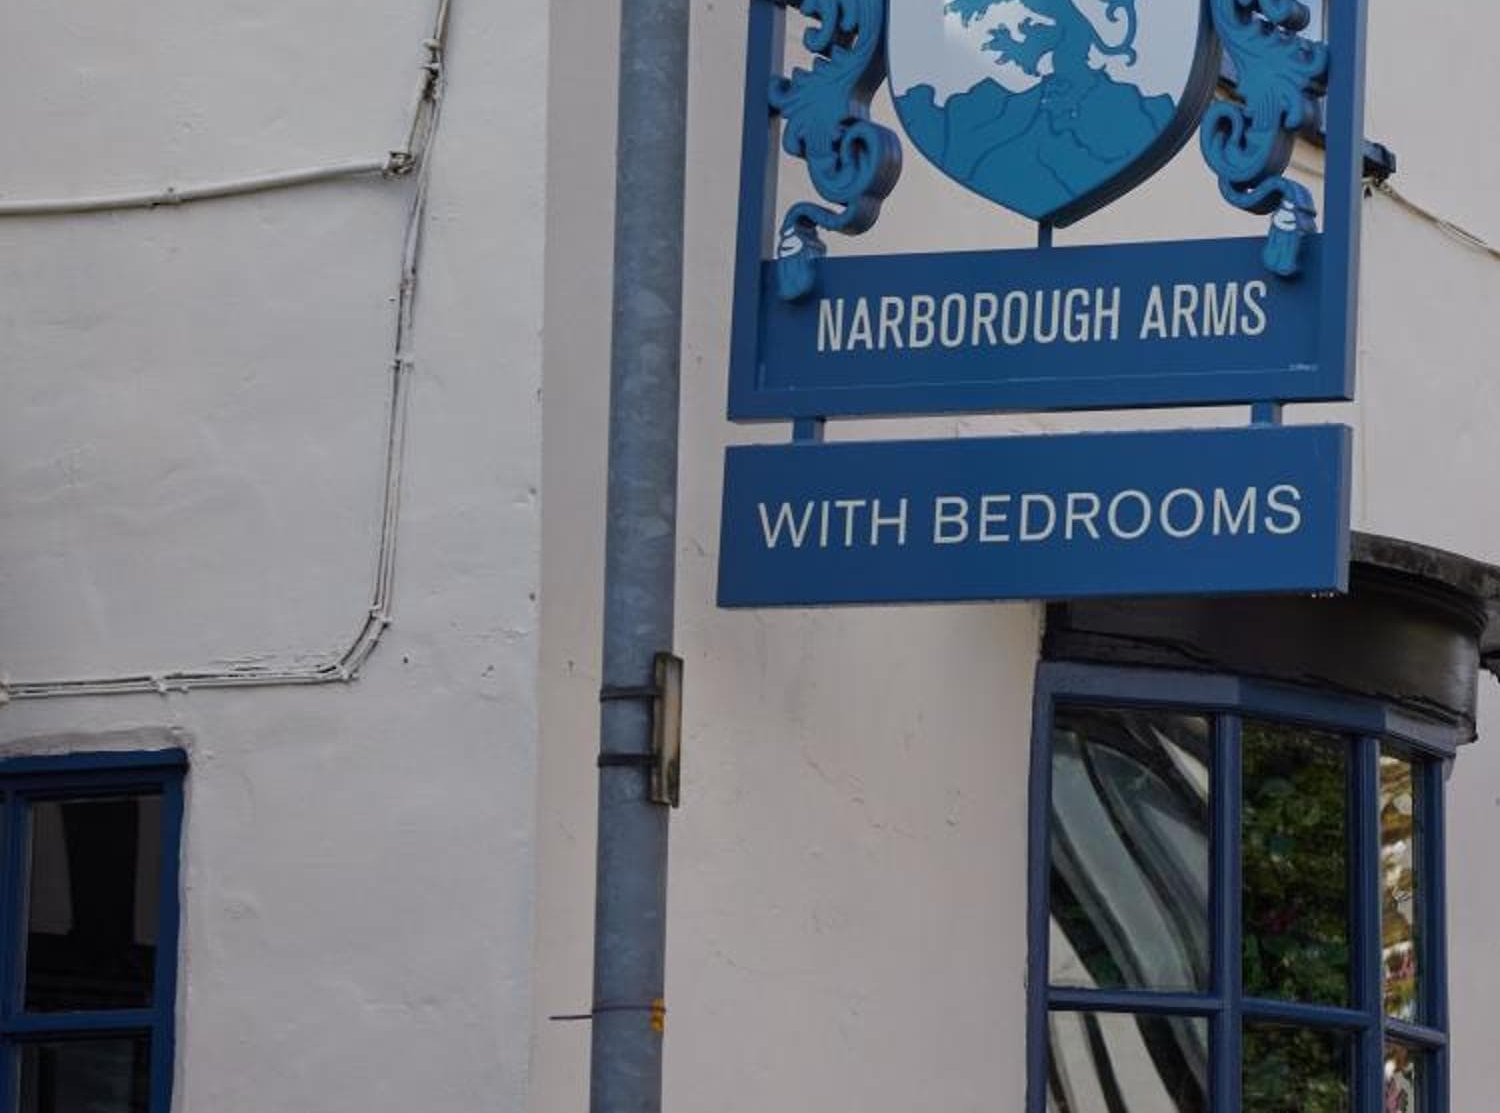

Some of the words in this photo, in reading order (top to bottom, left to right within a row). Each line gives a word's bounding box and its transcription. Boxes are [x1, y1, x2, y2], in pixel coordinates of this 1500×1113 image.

[817, 286, 1120, 352] NARBOROUGH
[1140, 280, 1267, 340] ARMS
[758, 497, 908, 549] WITH
[933, 484, 1302, 545] BEDROOMS
